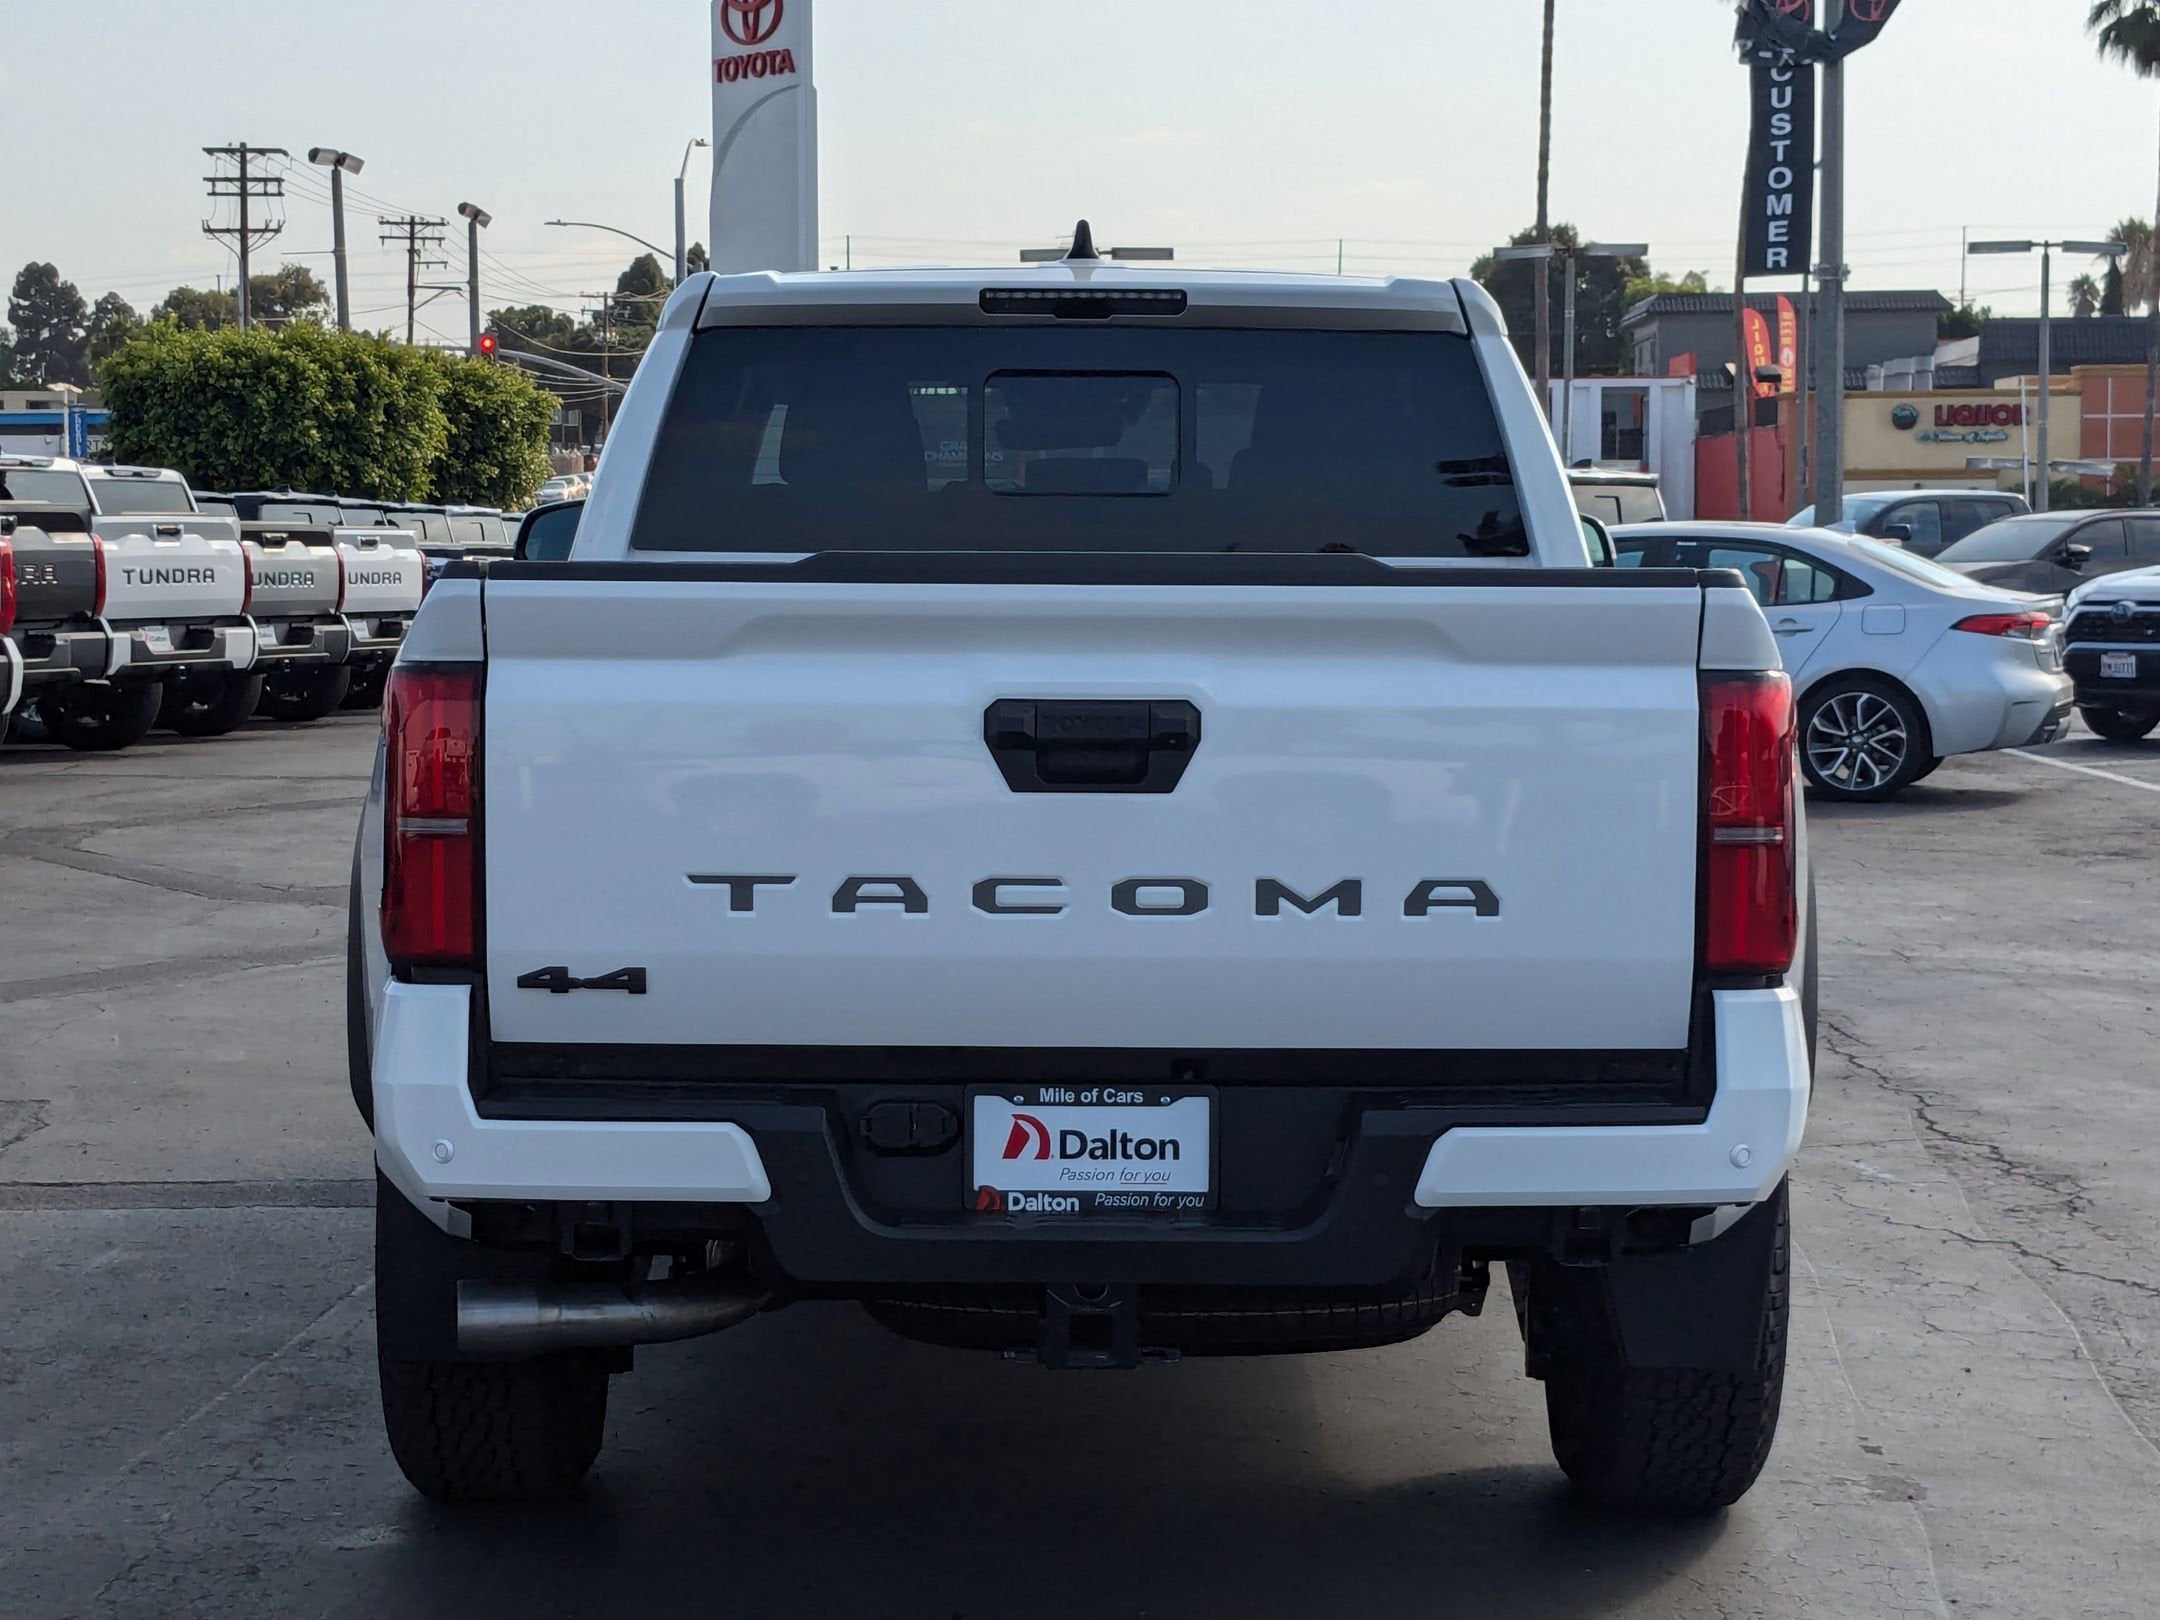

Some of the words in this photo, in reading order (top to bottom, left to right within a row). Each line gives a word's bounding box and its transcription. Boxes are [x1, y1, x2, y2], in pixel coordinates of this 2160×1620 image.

[713, 48, 796, 83] TOYOTA
[1766, 67, 1793, 269] CUSTOMER
[1934, 404, 2030, 426] LIQUOR
[121, 566, 216, 585] TUNDRA
[251, 571, 315, 588] UNDRA
[348, 571, 402, 585] UNDRA
[686, 873, 1500, 917] TACOMA
[1039, 1088, 1075, 1103] Mile
[1081, 1088, 1099, 1103] of
[1103, 1088, 1144, 1104] Cars
[1059, 1128, 1181, 1161] Dalton
[1058, 1167, 1115, 1182] Passion
[1119, 1166, 1140, 1182] for
[1143, 1170, 1172, 1184] you
[1007, 1191, 1080, 1212] Dalton
[1094, 1192, 1149, 1207] Passion
[1152, 1193, 1175, 1207] for
[1177, 1196, 1205, 1210] you
